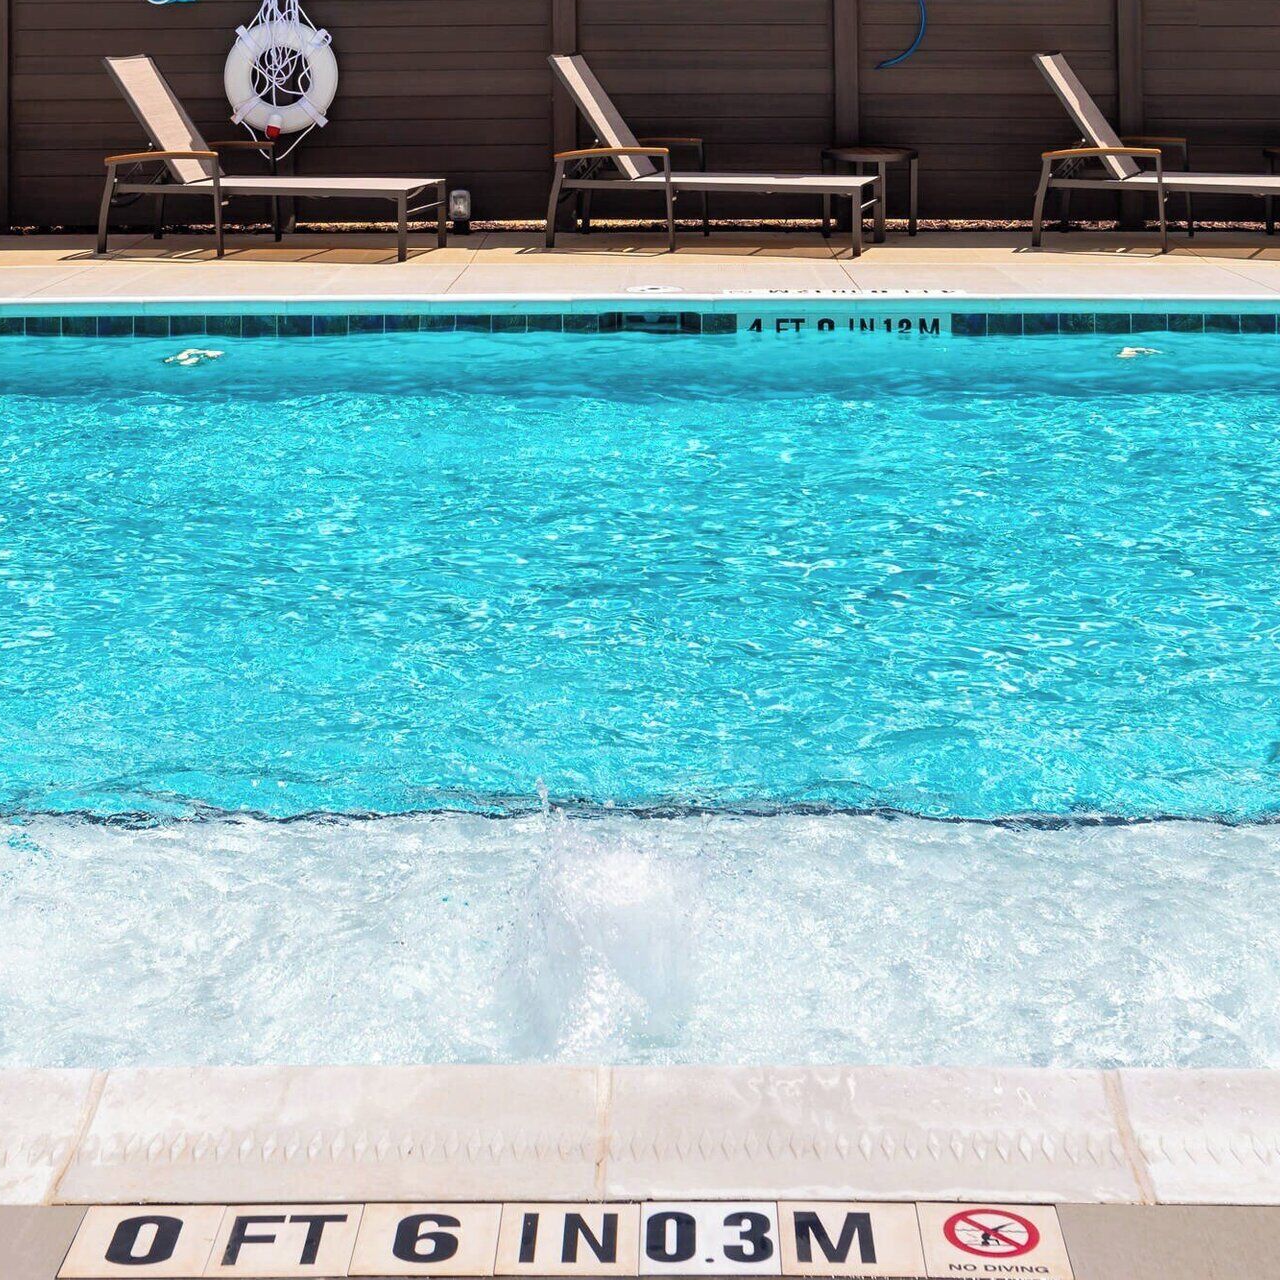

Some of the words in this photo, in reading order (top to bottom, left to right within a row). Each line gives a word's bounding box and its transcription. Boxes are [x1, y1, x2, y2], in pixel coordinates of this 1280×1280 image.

[746, 318, 762, 333] 4
[775, 318, 806, 333] FT
[849, 318, 875, 332] IN
[104, 1214, 184, 1266] 0
[220, 1213, 349, 1266] FT
[392, 1213, 462, 1264] 6
[518, 1212, 619, 1264] IN
[948, 1263, 978, 1272] NO
[983, 1264, 1050, 1274] DIVING
